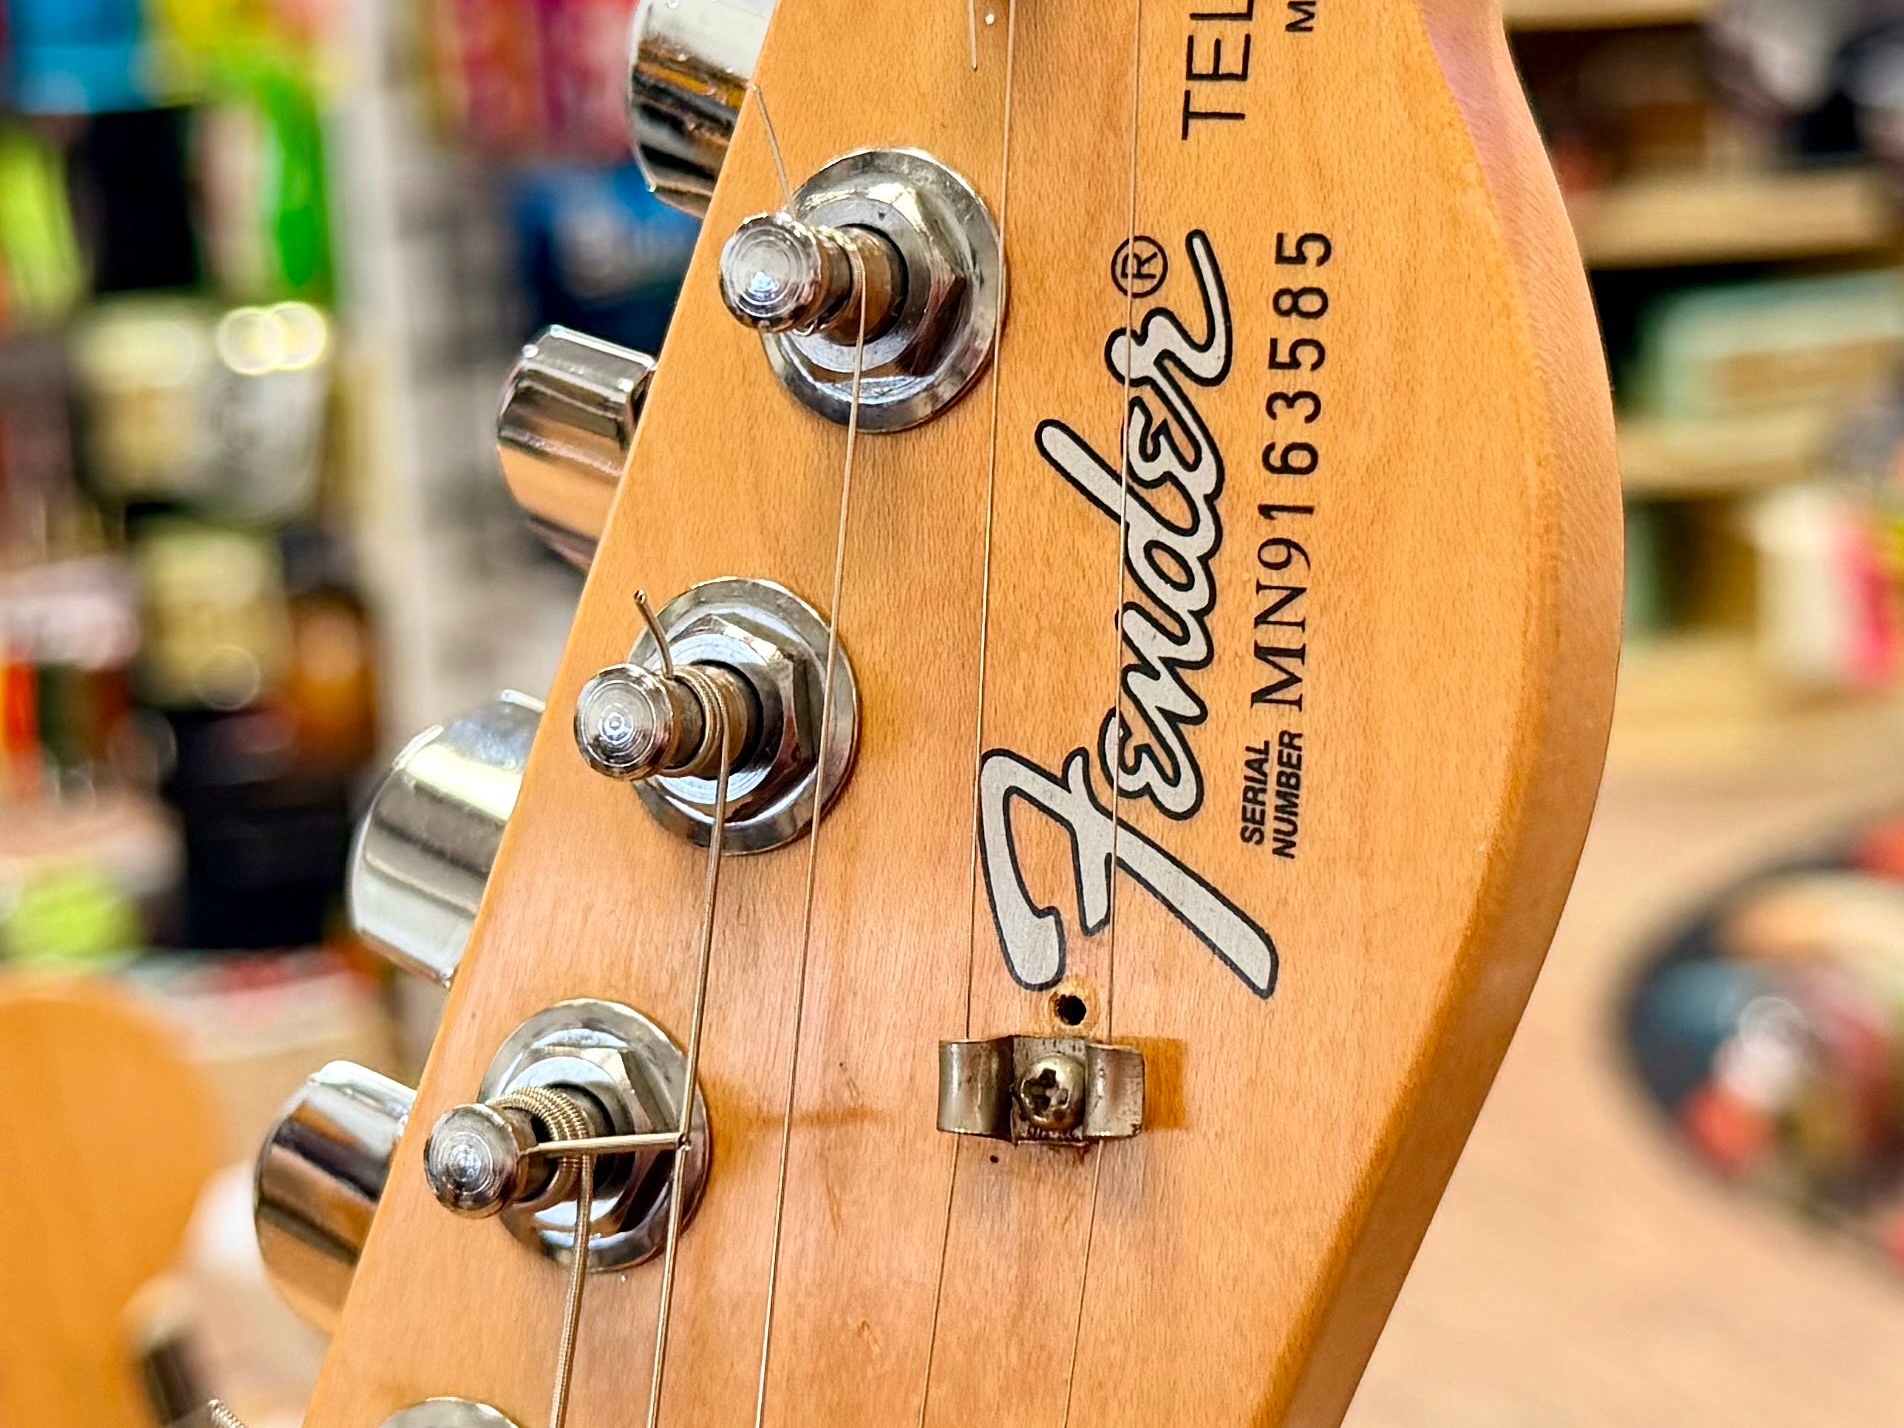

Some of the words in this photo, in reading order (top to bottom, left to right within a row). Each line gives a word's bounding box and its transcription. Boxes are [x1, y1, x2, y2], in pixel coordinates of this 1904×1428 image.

[1250, 231, 1333, 712] MN9163585
[1239, 739, 1272, 844] SERIAL
[1271, 730, 1305, 860] NUMBER
